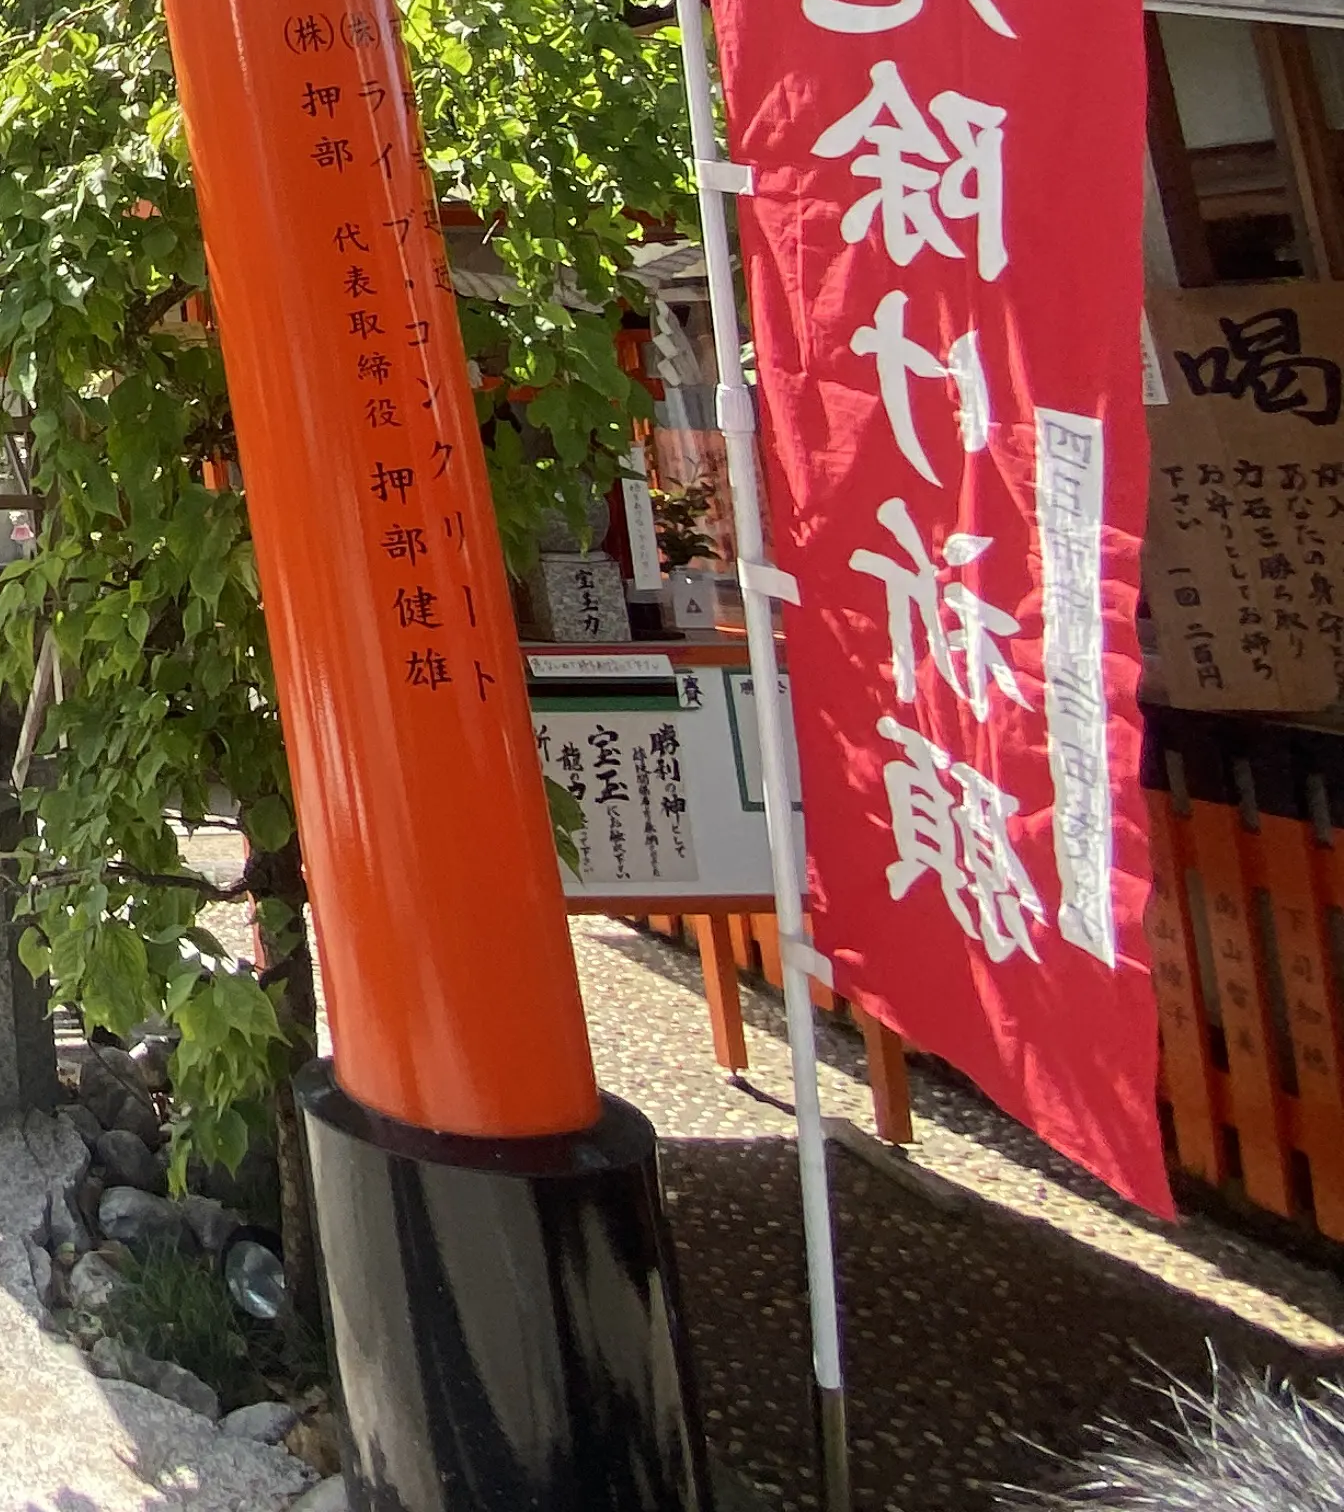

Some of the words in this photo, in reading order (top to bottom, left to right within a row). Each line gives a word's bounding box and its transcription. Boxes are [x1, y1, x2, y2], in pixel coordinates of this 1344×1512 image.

[331, 222, 403, 430] 代表取締役
[369, 460, 454, 692] 押部健雄
